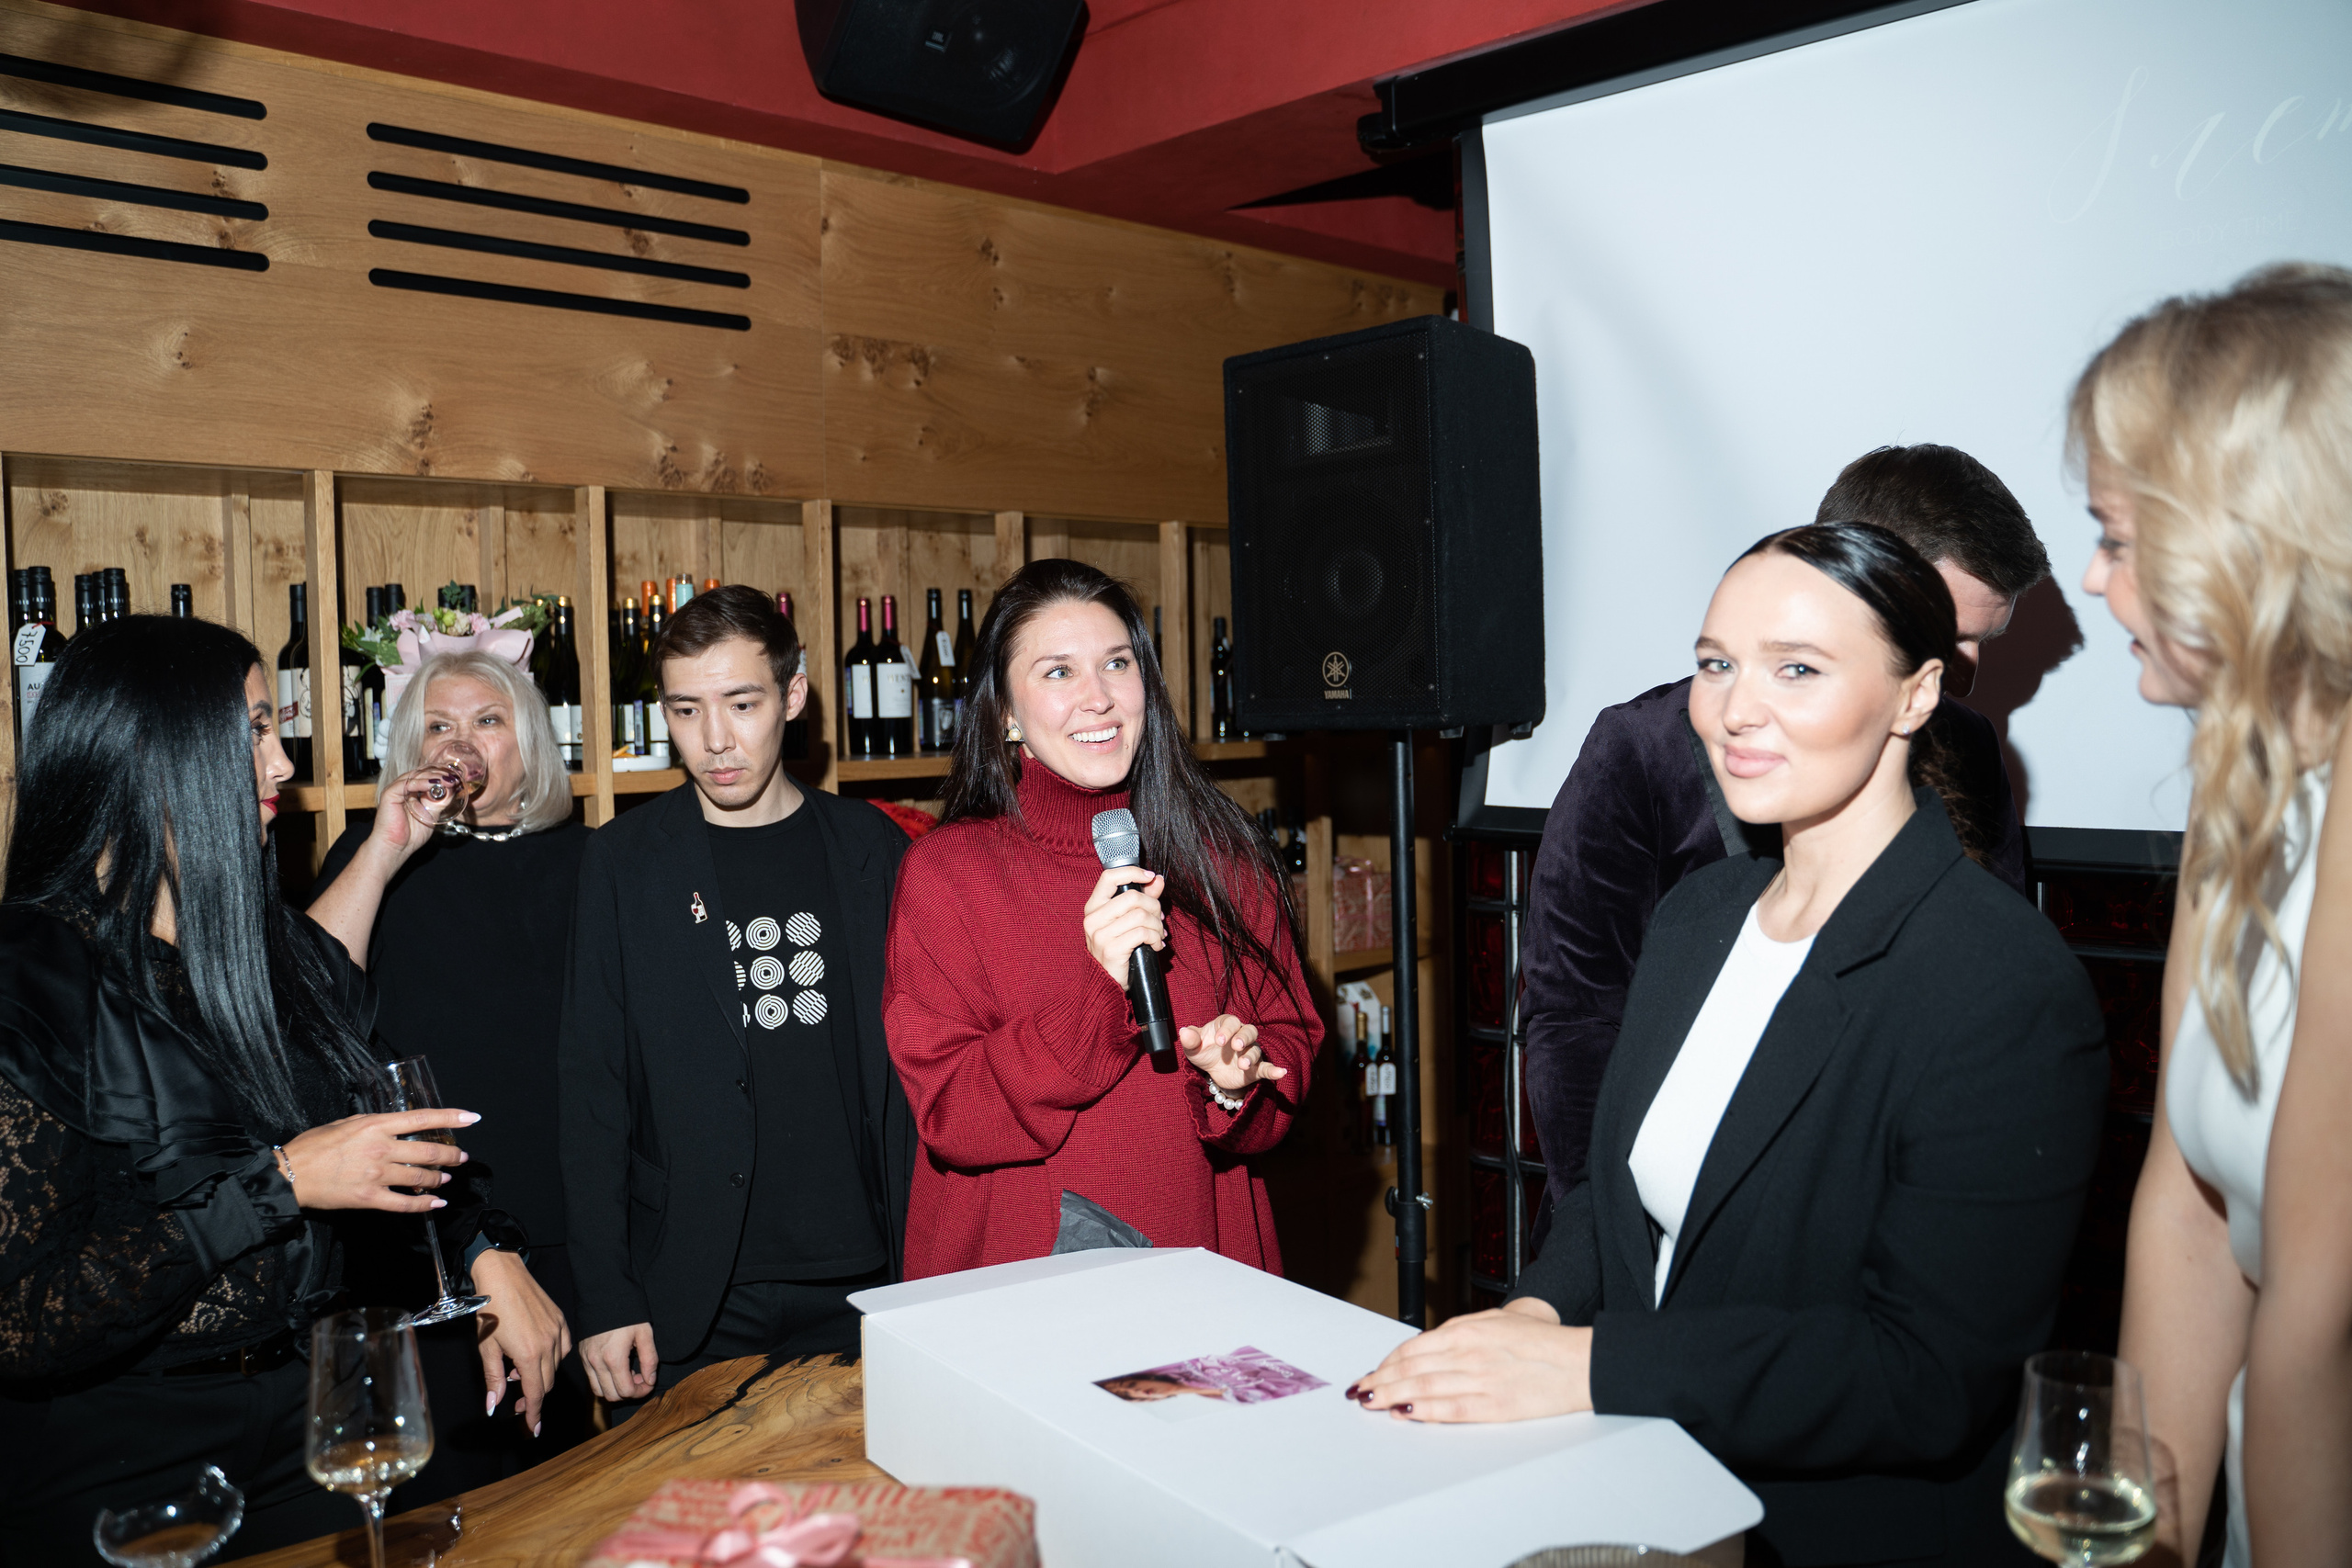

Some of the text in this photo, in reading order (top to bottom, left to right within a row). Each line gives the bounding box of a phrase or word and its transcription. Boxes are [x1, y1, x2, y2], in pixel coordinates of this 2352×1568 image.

[2158, 210, 2300, 250] BODY TIME
[16, 630, 38, 663] 7500
[1324, 690, 1350, 700] YAMAHA
